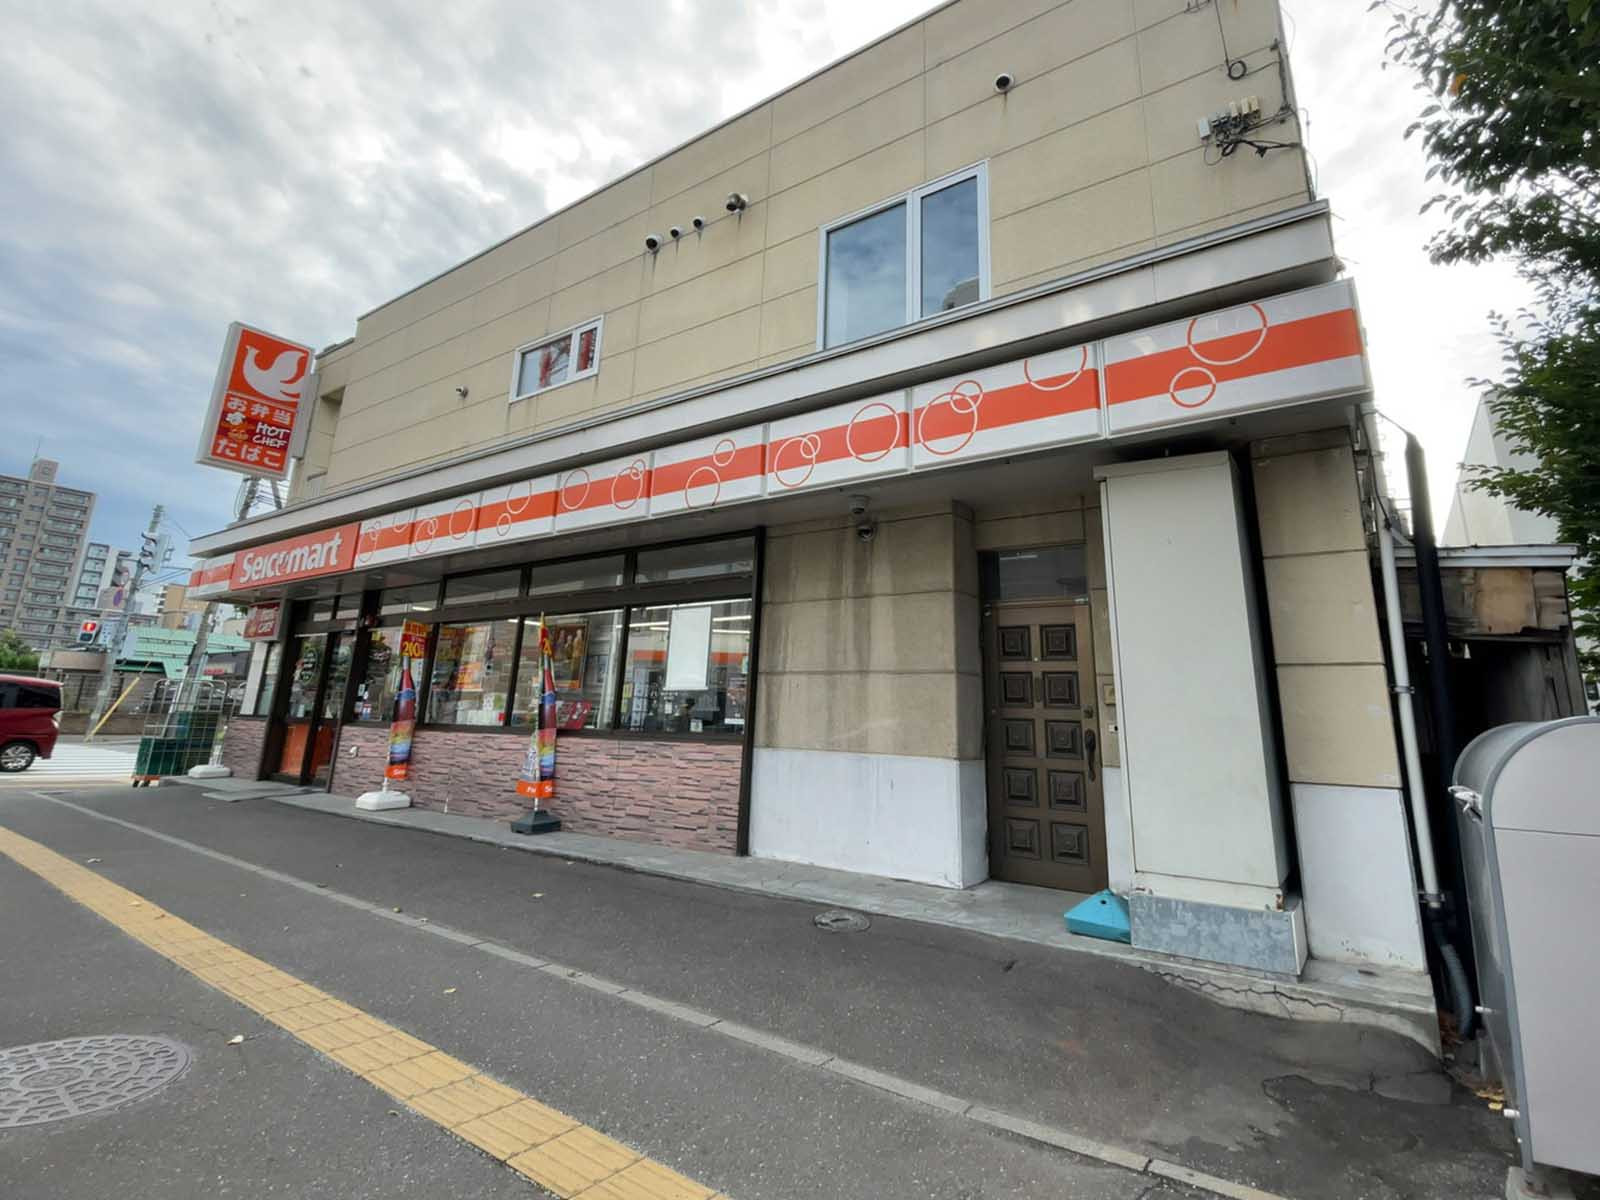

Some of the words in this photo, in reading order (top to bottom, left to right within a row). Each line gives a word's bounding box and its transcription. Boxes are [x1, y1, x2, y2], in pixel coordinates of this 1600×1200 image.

[226, 397, 291, 424] お弁当
[252, 434, 288, 448] CHEF
[255, 421, 290, 439] HOT
[216, 438, 281, 467] たばこ
